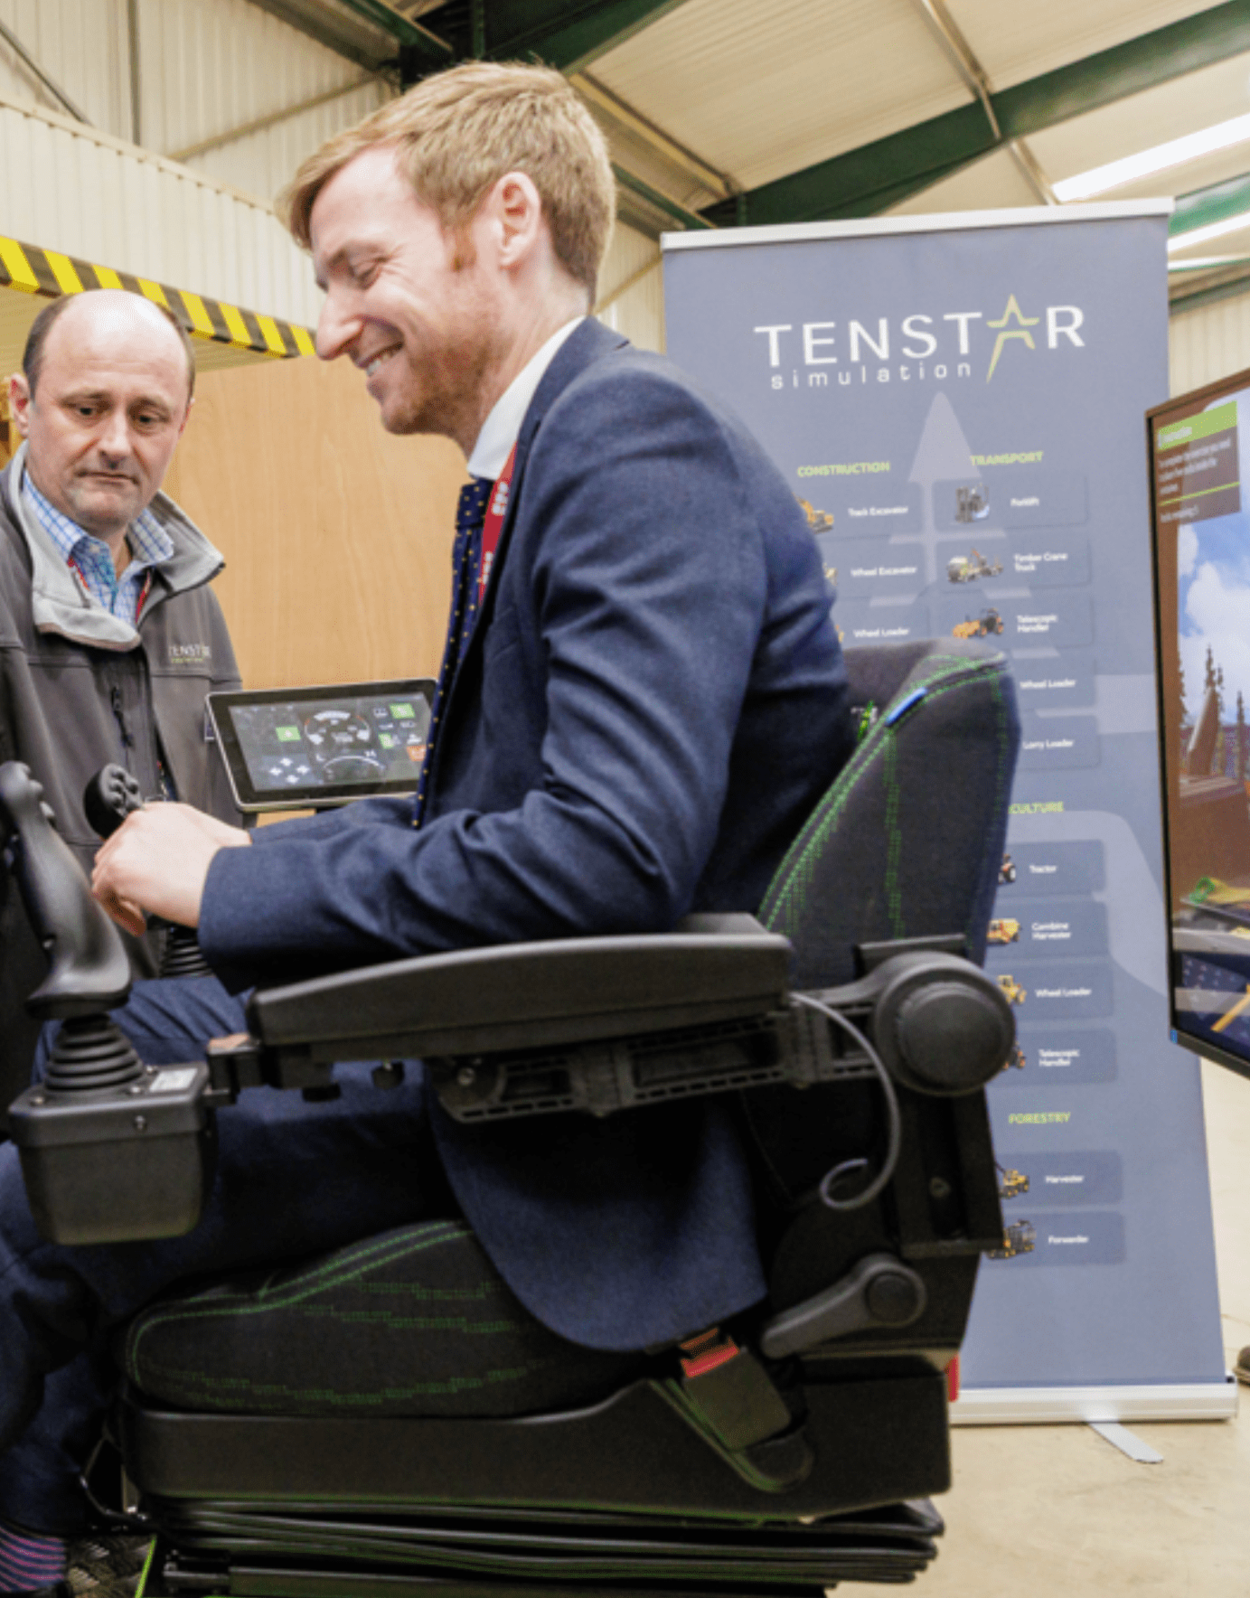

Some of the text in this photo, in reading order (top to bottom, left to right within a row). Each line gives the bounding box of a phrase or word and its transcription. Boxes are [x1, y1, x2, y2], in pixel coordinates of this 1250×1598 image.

[771, 361, 972, 390] simulation
[970, 450, 1044, 466] TRANSPORT
[797, 461, 891, 478] CONSTRUCTION
[1010, 497, 1040, 508] Forklift
[869, 505, 909, 517] Excavator
[1014, 552, 1068, 563] Timber Crane
[851, 565, 918, 578] Wheel Excavator
[853, 627, 910, 639] Wheel Loader
[1020, 678, 1077, 690] Wheel Loader
[1046, 738, 1074, 748] Loader
[1008, 801, 1064, 815] CULTURE
[1031, 922, 1069, 931] Combine
[1035, 987, 1092, 998] Wheel Loader
[1008, 1111, 1071, 1124] FORESTRY
